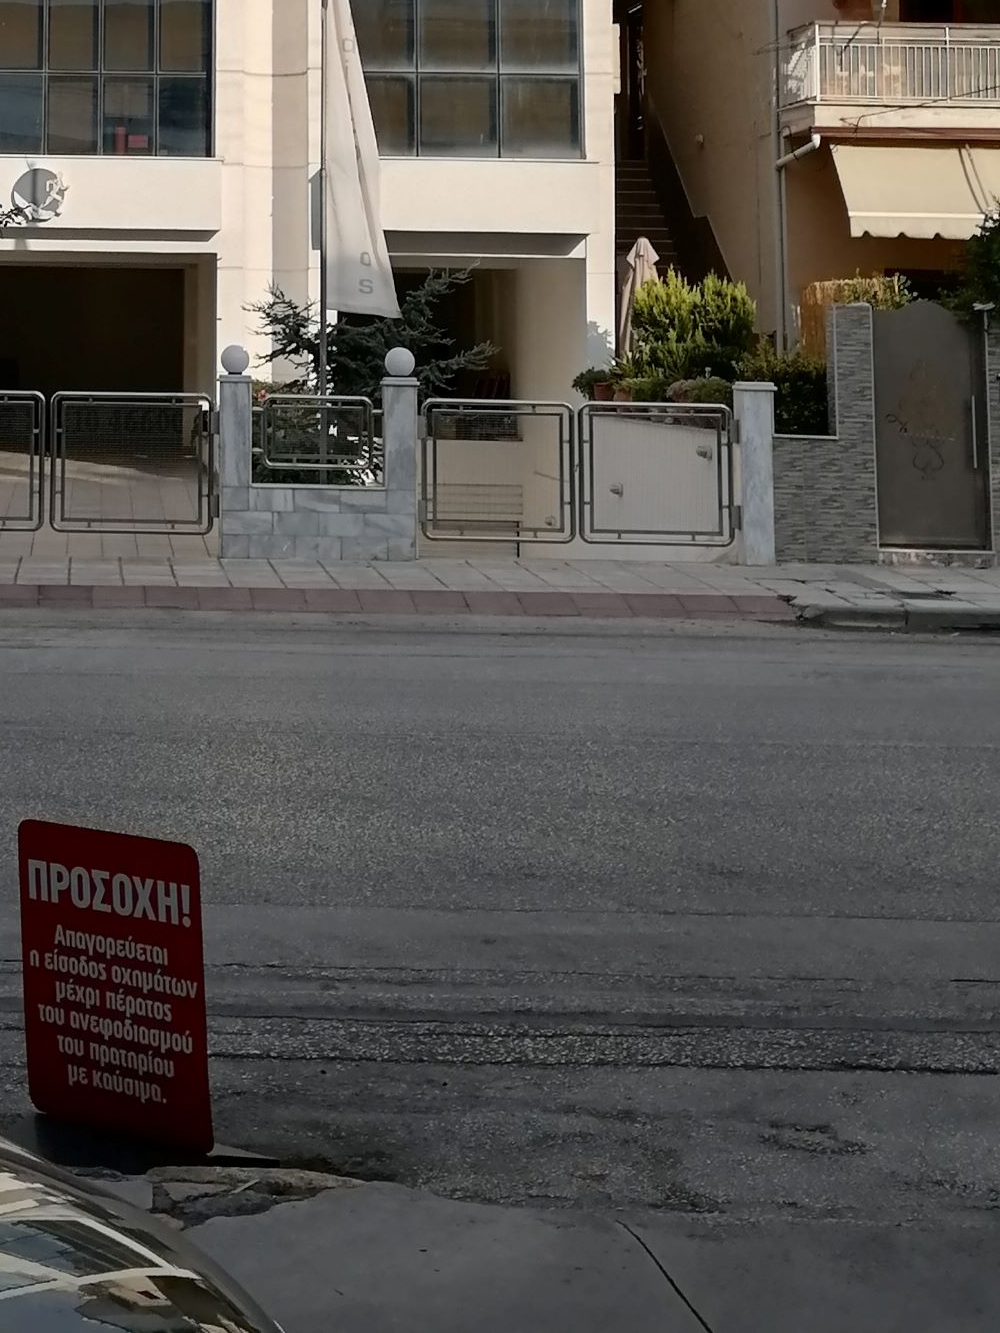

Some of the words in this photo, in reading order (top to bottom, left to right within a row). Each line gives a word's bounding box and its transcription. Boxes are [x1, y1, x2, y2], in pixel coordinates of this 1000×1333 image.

[27, 858, 191, 928] ΠΡΟΣΟΧΗ!
[54, 924, 168, 966] Απαγορεύεται
[29, 949, 39, 967] η
[44, 949, 106, 981] είσοδος
[111, 965, 197, 999] οχημάτων
[55, 979, 100, 1009] μέχρι
[105, 988, 172, 1022] πέρατος
[38, 1003, 65, 1026] του
[70, 1010, 193, 1054] ανεφοδιασμού
[57, 1035, 84, 1056] του
[89, 1042, 175, 1078] πρατηρίου
[67, 1063, 88, 1086] με
[92, 1070, 167, 1103] καύσιμα.
